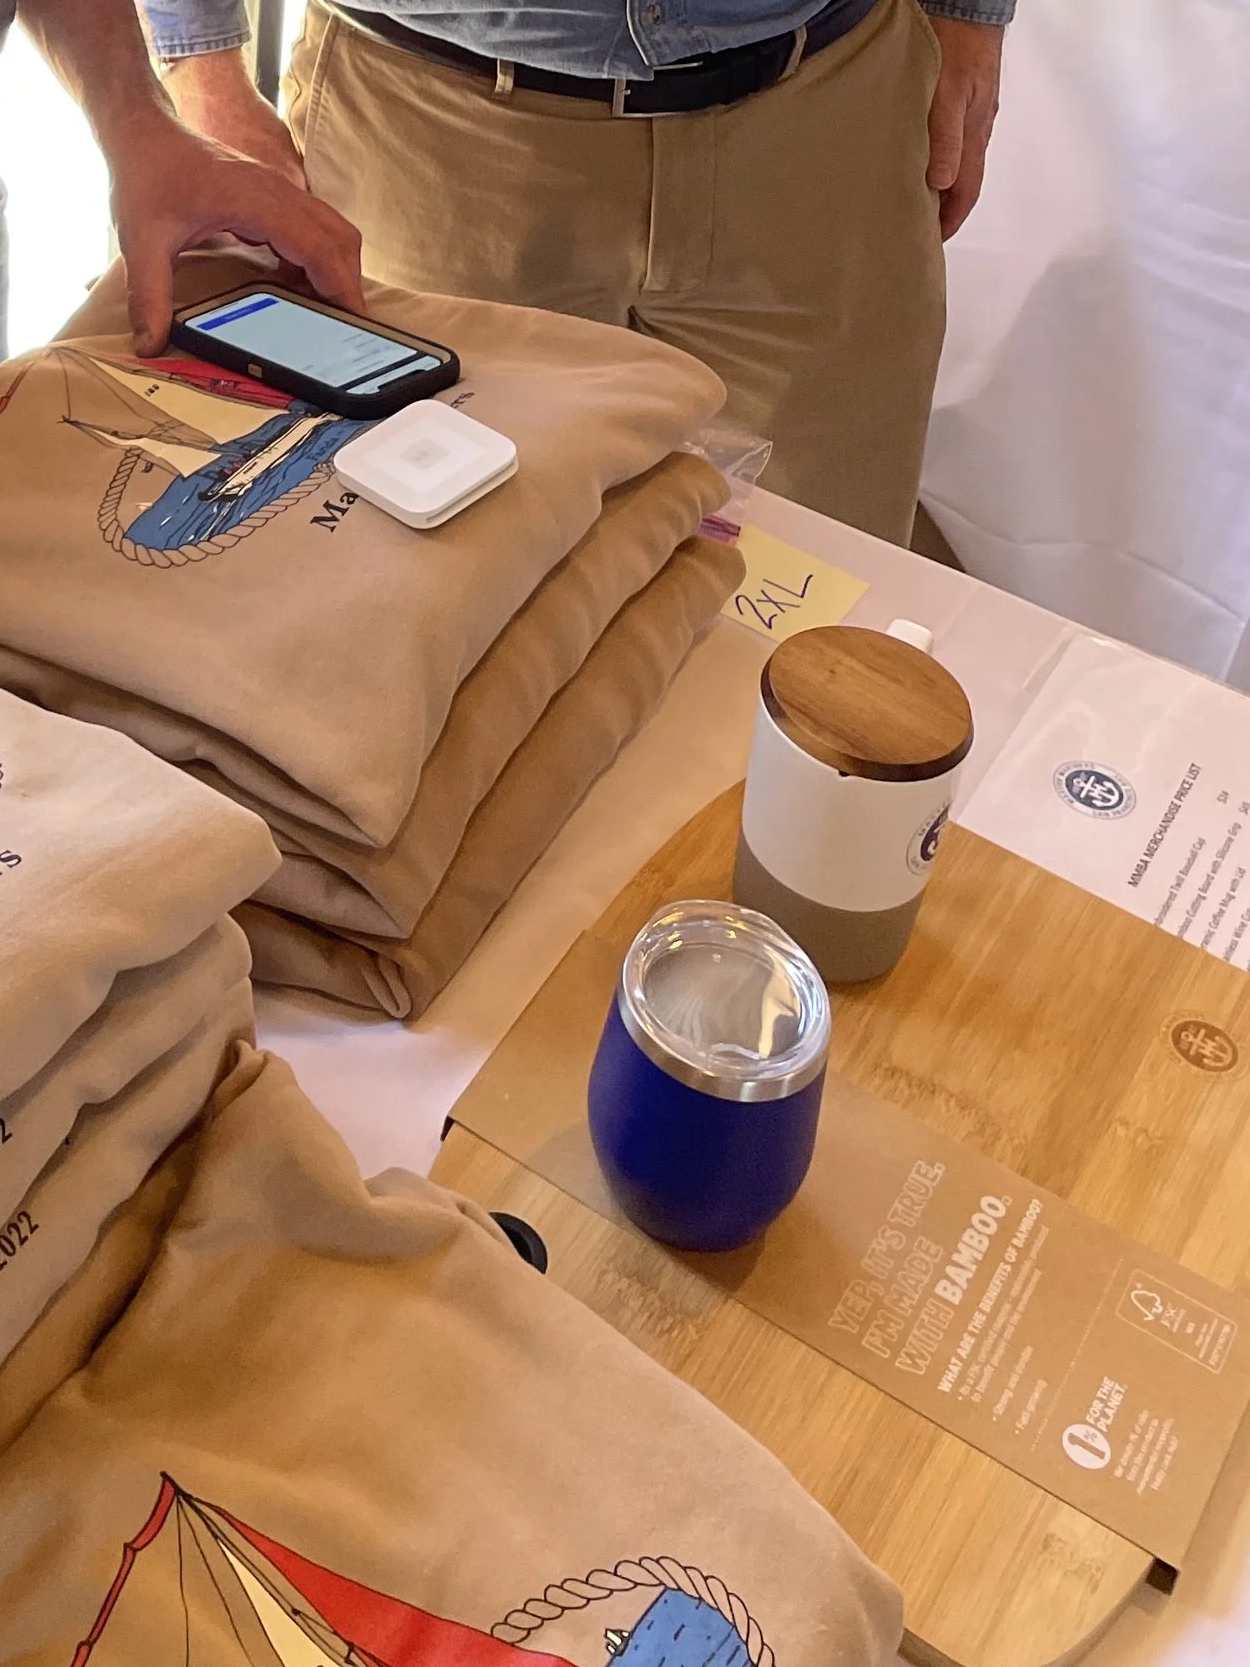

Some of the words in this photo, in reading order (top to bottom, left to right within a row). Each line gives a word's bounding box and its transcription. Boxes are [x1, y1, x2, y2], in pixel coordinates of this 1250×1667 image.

[735, 573, 814, 630] 2XL
[1127, 858, 1151, 888] MMBA
[1143, 800, 1182, 860] MERCHANDISE
[1174, 778, 1194, 803] PRICE
[1186, 762, 1202, 781] LIST
[1208, 907, 1226, 929] Coffee
[1219, 892, 1236, 908] Mug
[860, 1224, 906, 1280] IT'S
[887, 1160, 946, 1228] TRUE.
[1011, 1198, 1044, 1249] BAMBOO?
[883, 1235, 944, 1317] MADE
[1004, 1246, 1019, 1263] OF
[895, 1297, 955, 1376] WITH
[934, 1194, 1014, 1306] BAMBOO.
[978, 1261, 1013, 1314] BENEFITS
[861, 1308, 906, 1360] I'M
[956, 1332, 976, 1360] ARE
[967, 1310, 987, 1334] THE
[938, 1356, 964, 1393] WHAT
[1086, 1399, 1105, 1426] FOR
[1096, 1376, 1115, 1400] THE
